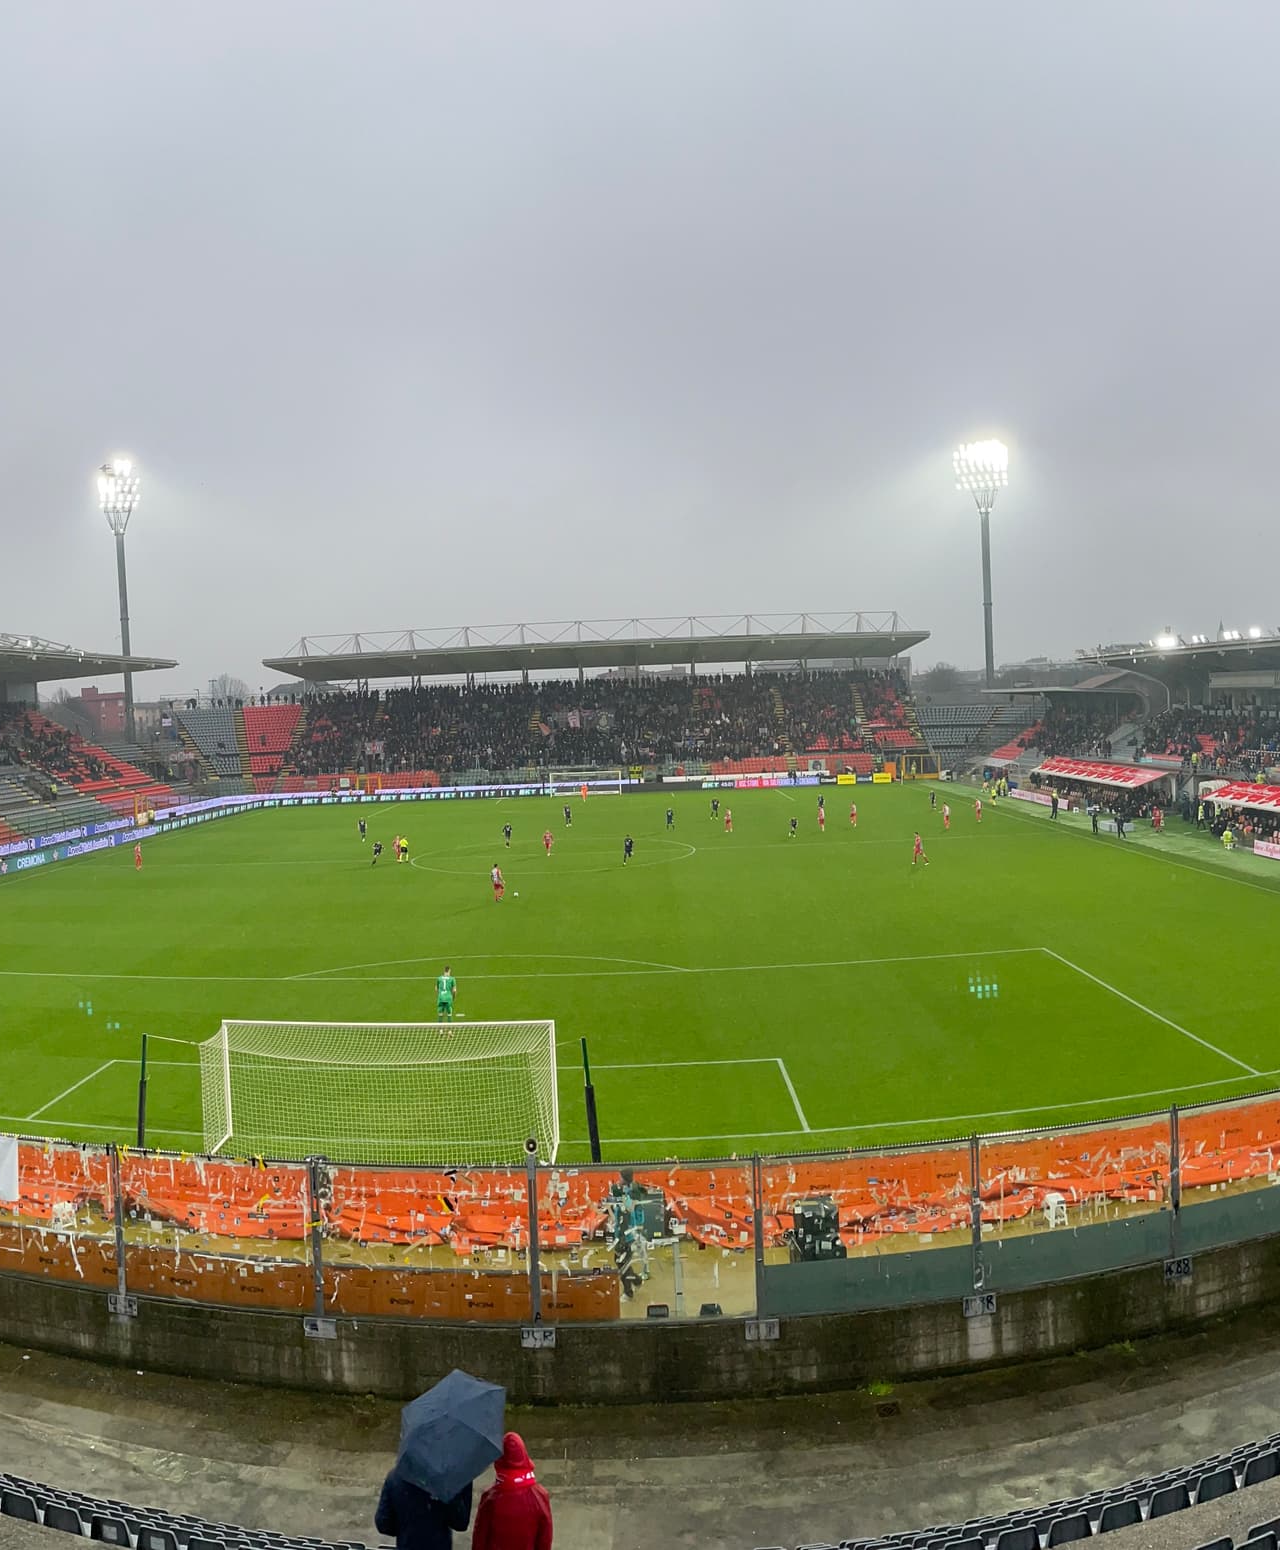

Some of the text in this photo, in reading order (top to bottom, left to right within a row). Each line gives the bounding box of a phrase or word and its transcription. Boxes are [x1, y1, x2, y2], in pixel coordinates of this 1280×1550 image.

[40, 834, 55, 846] Arvedi
[67, 844, 83, 857] Arvedi
[16, 854, 45, 869] CREMONA
